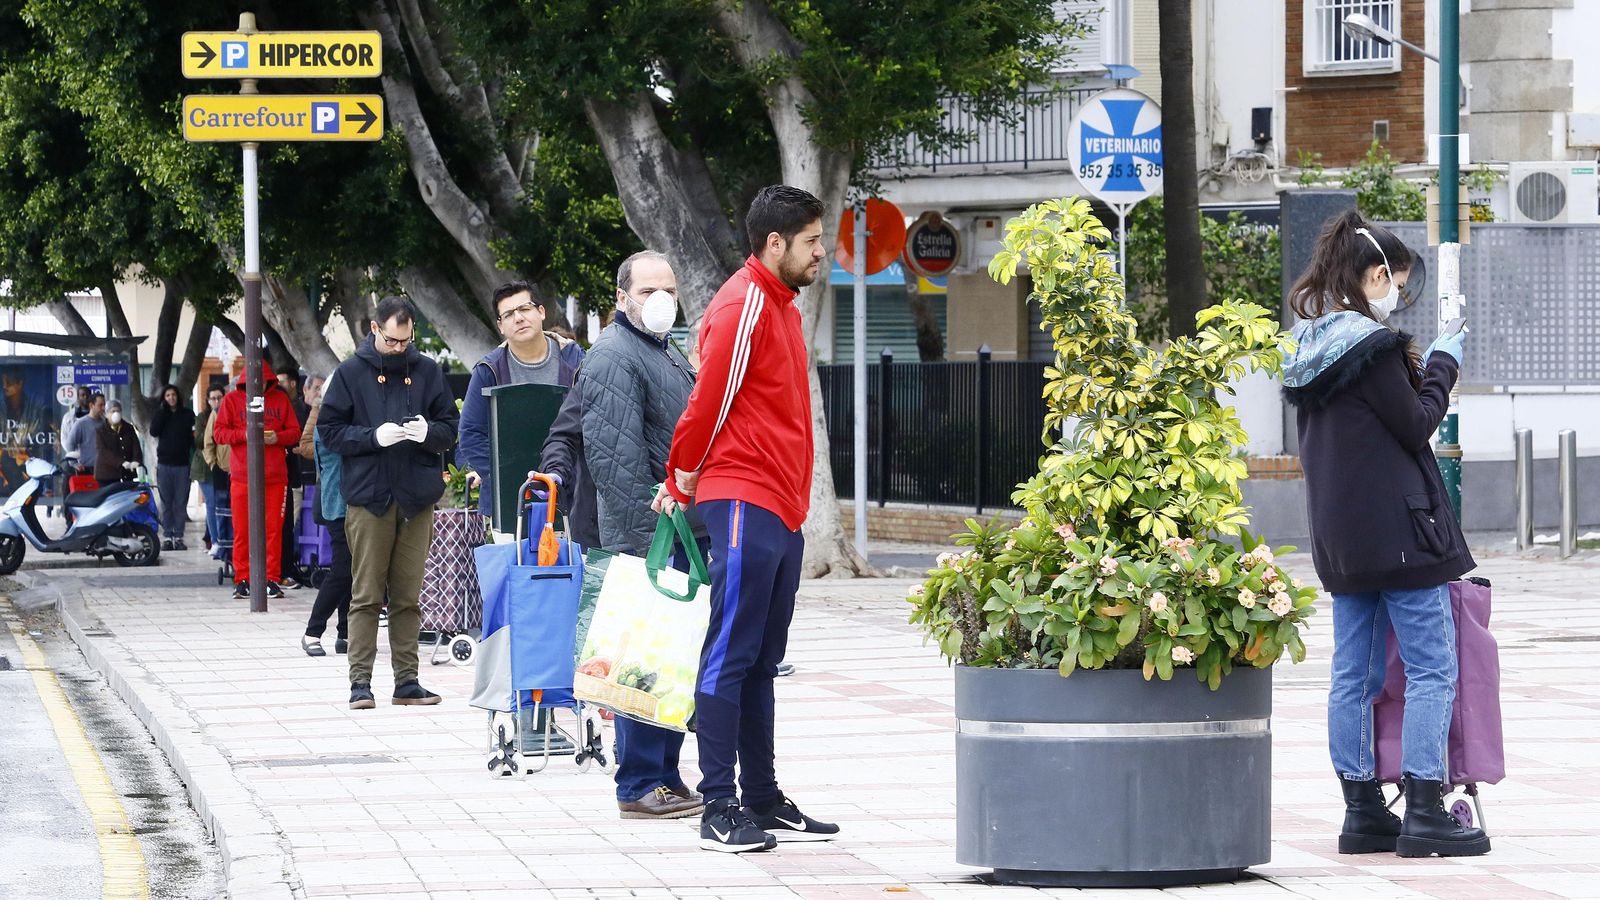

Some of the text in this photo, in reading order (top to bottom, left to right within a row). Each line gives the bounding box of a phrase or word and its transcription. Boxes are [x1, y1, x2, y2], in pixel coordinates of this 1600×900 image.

[226, 43, 374, 67] P HIPERCOR
[189, 106, 336, 131] Carrefour P
[1085, 137, 1161, 154] VETERINARIO
[1080, 163, 1161, 179] 952 35 35 35
[918, 232, 952, 245] Estrella
[919, 245, 951, 257] Galicia
[61, 387, 74, 398] 15
